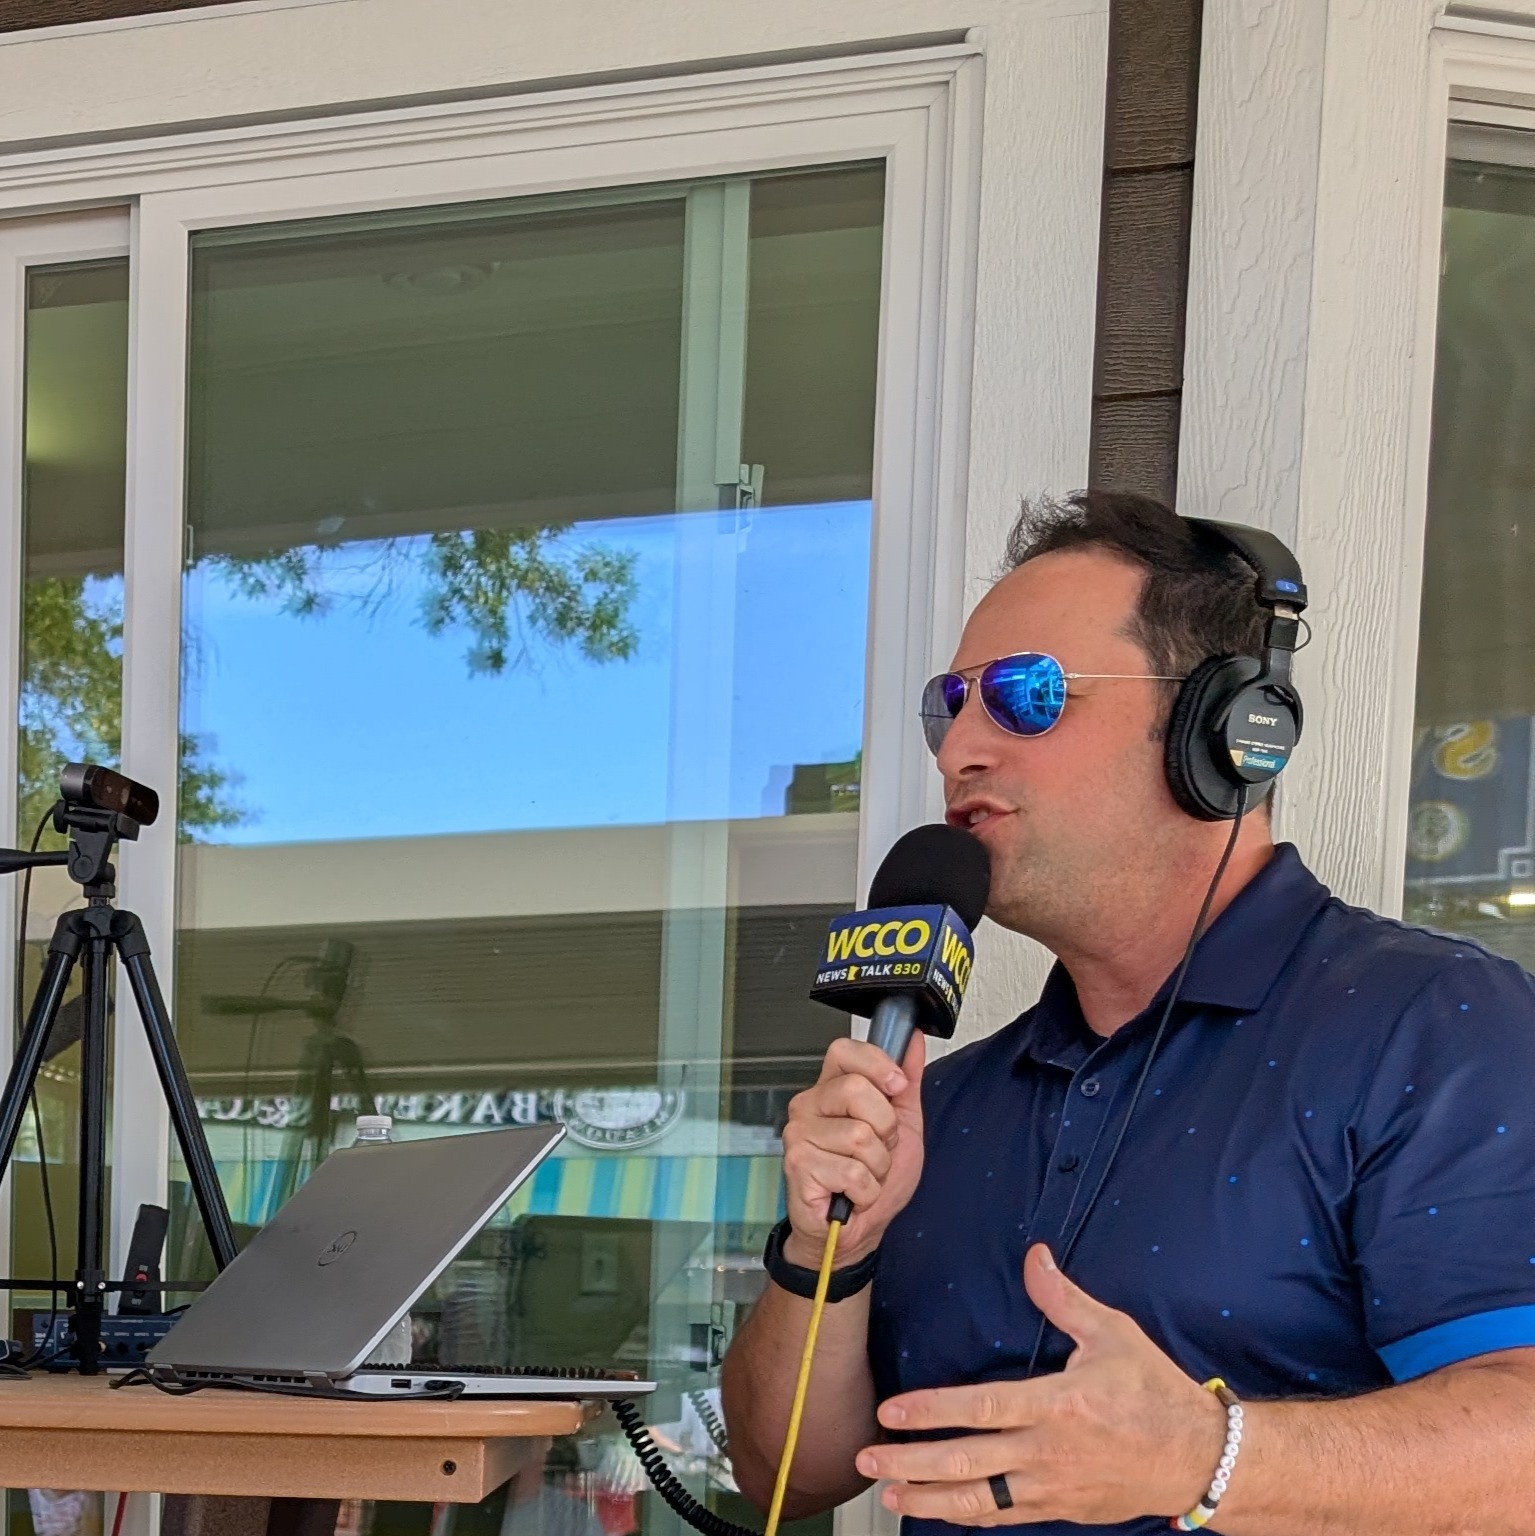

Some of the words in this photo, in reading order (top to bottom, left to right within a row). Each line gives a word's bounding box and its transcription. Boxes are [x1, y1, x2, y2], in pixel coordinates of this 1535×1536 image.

[1248, 713, 1277, 727] SONY
[827, 920, 930, 963] WCCO
[816, 968, 848, 984] NEWS
[860, 963, 893, 978] TALK
[893, 963, 921, 975] 830
